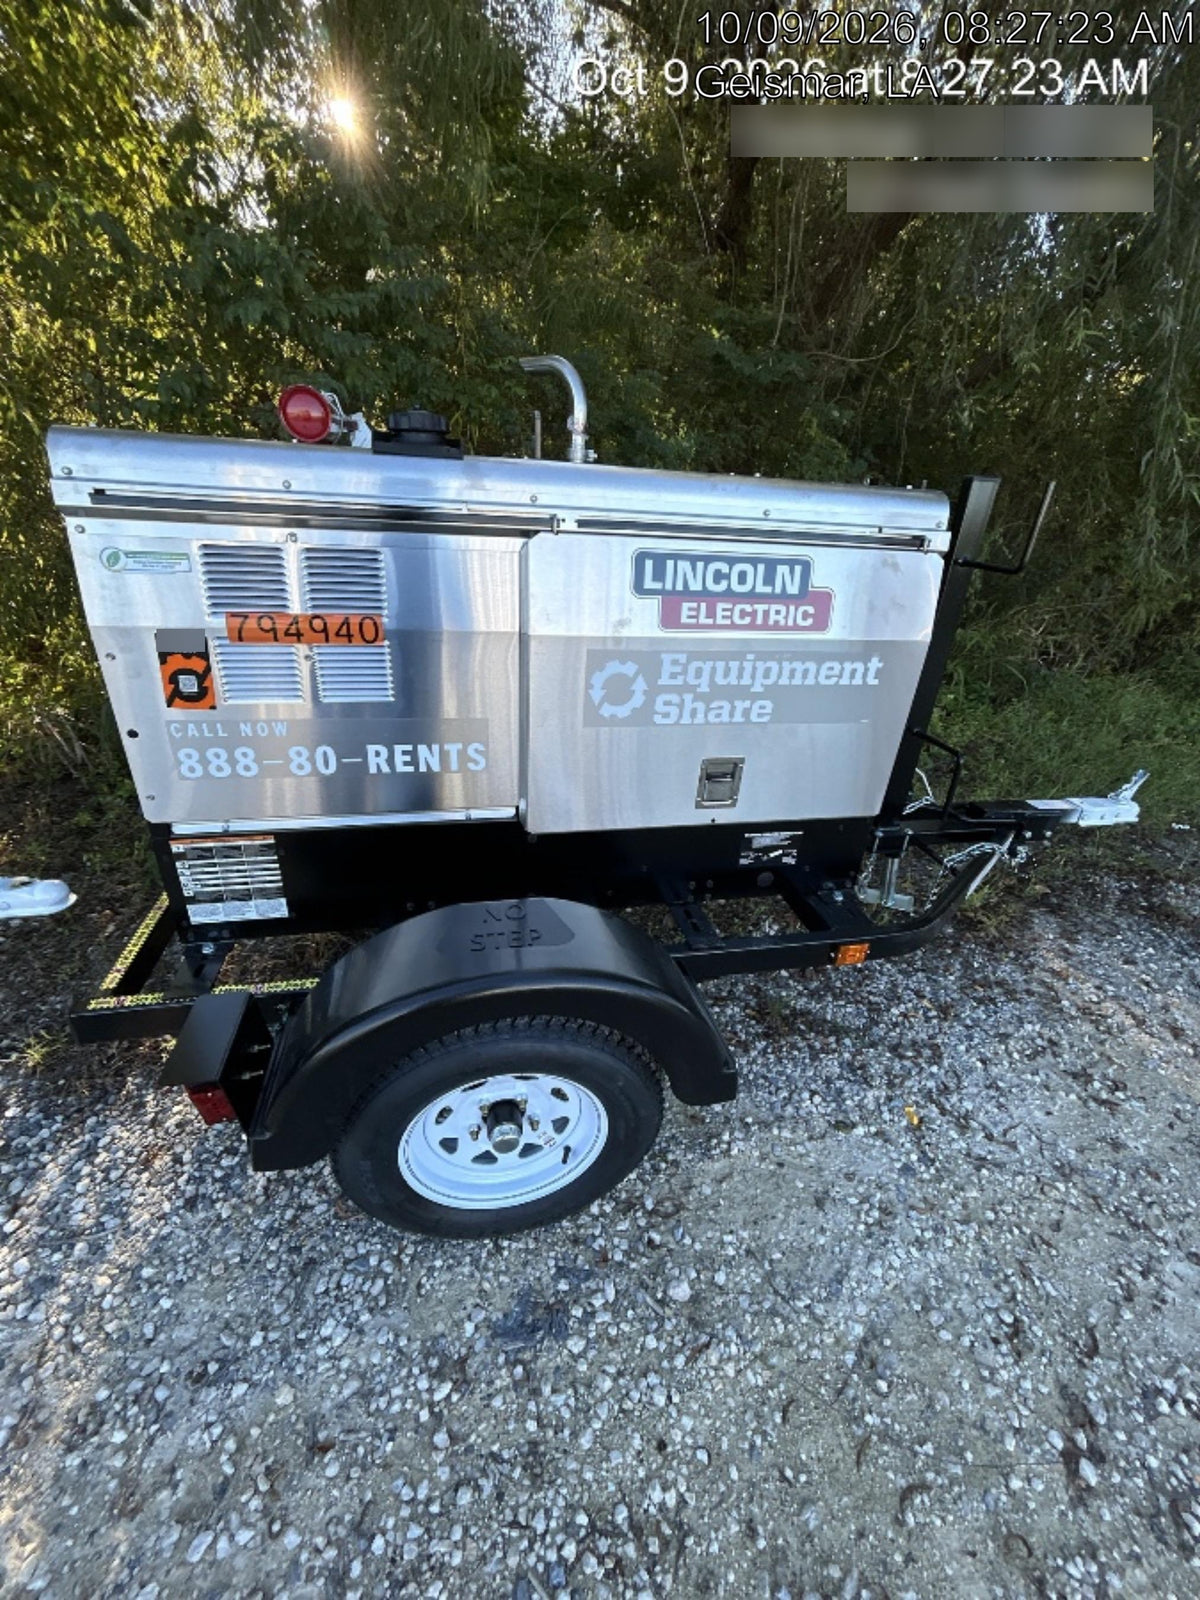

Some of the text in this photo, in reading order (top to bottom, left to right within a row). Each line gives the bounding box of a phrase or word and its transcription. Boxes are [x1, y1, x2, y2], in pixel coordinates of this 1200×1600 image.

[643, 559, 802, 595] LINCOLN
[680, 602, 816, 627] ELECTRIC
[229, 615, 379, 644] 794940
[658, 653, 883, 692] Equipment
[654, 694, 774, 724] Share
[170, 721, 288, 738] CALL NOW
[177, 742, 487, 778] 888-80-RENTS
[470, 929, 542, 952] STEP
